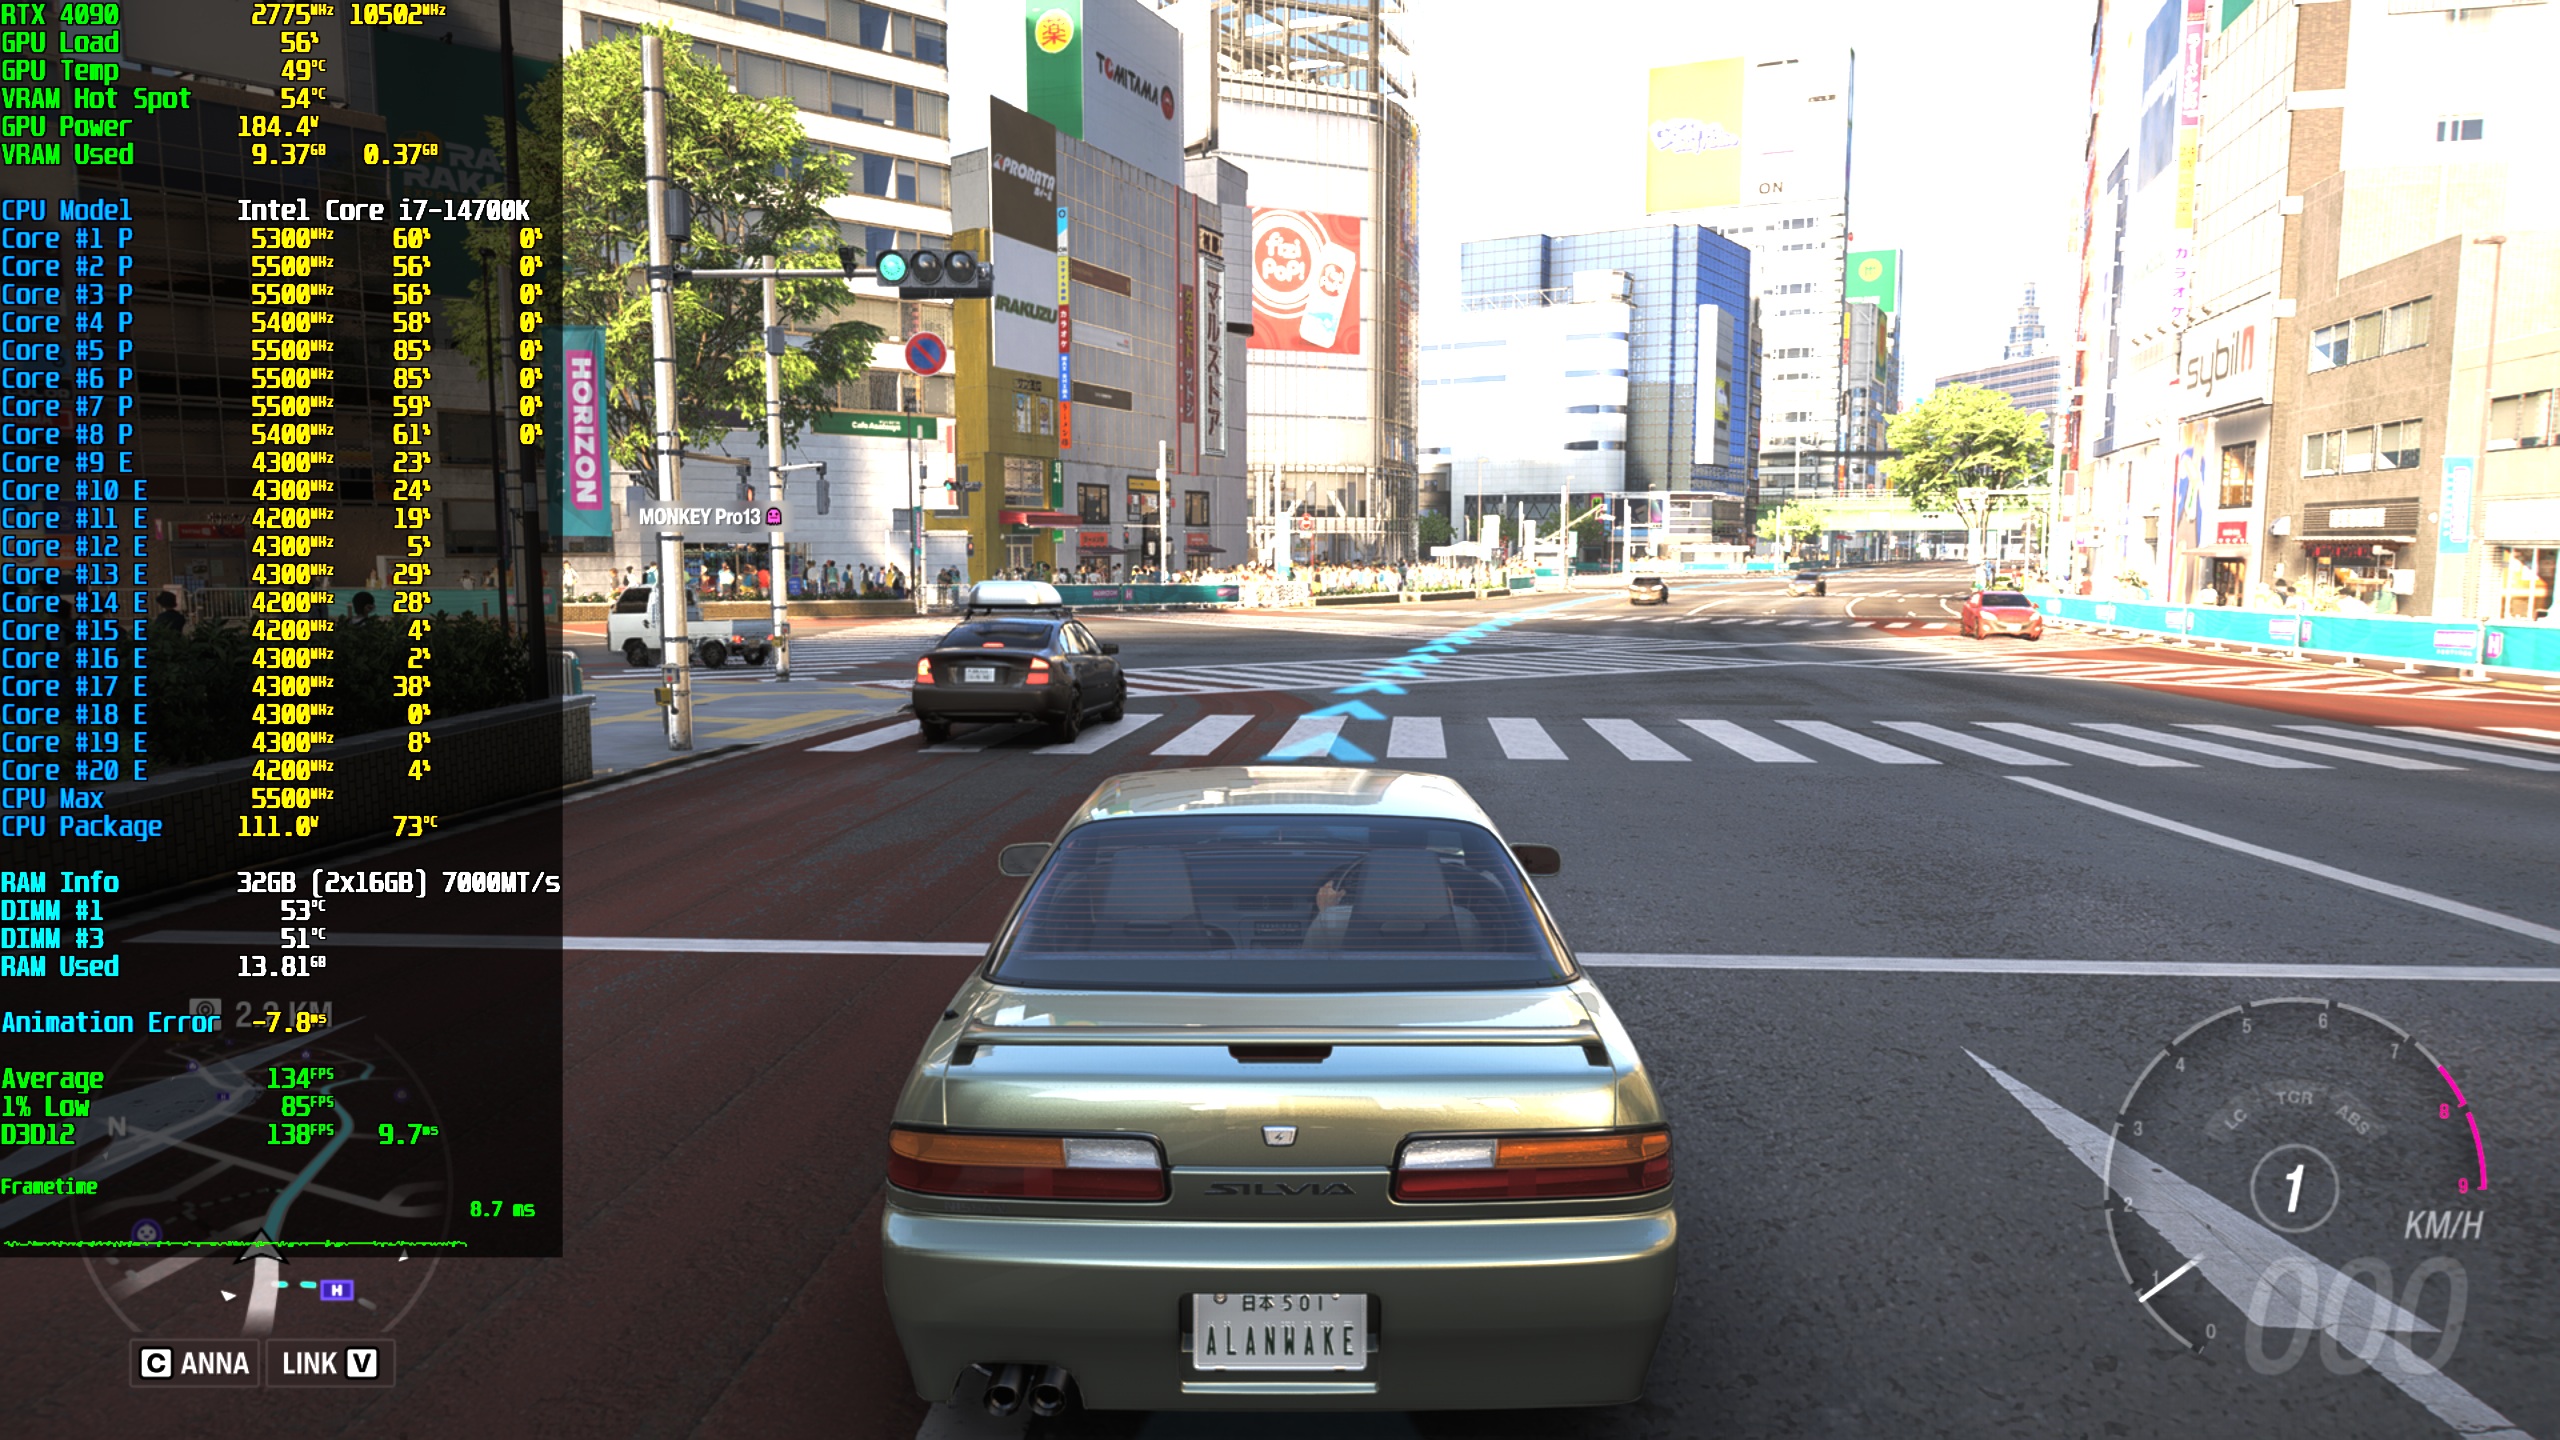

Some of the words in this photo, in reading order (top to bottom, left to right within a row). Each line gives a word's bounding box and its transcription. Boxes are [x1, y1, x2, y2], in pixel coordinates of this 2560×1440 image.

[1096, 51, 1159, 106] TOMITAMA
[1002, 156, 1056, 191] PRORATA
[1759, 182, 1784, 194] ON
[2172, 247, 2188, 318] カラオケ
[995, 294, 1058, 325] IRAKUZU
[570, 356, 598, 506] HORIZON
[1204, 1182, 1356, 1196] SILVIA
[1242, 1295, 1275, 1312] 日本
[1206, 1326, 1354, 1356] ALANWAKE
